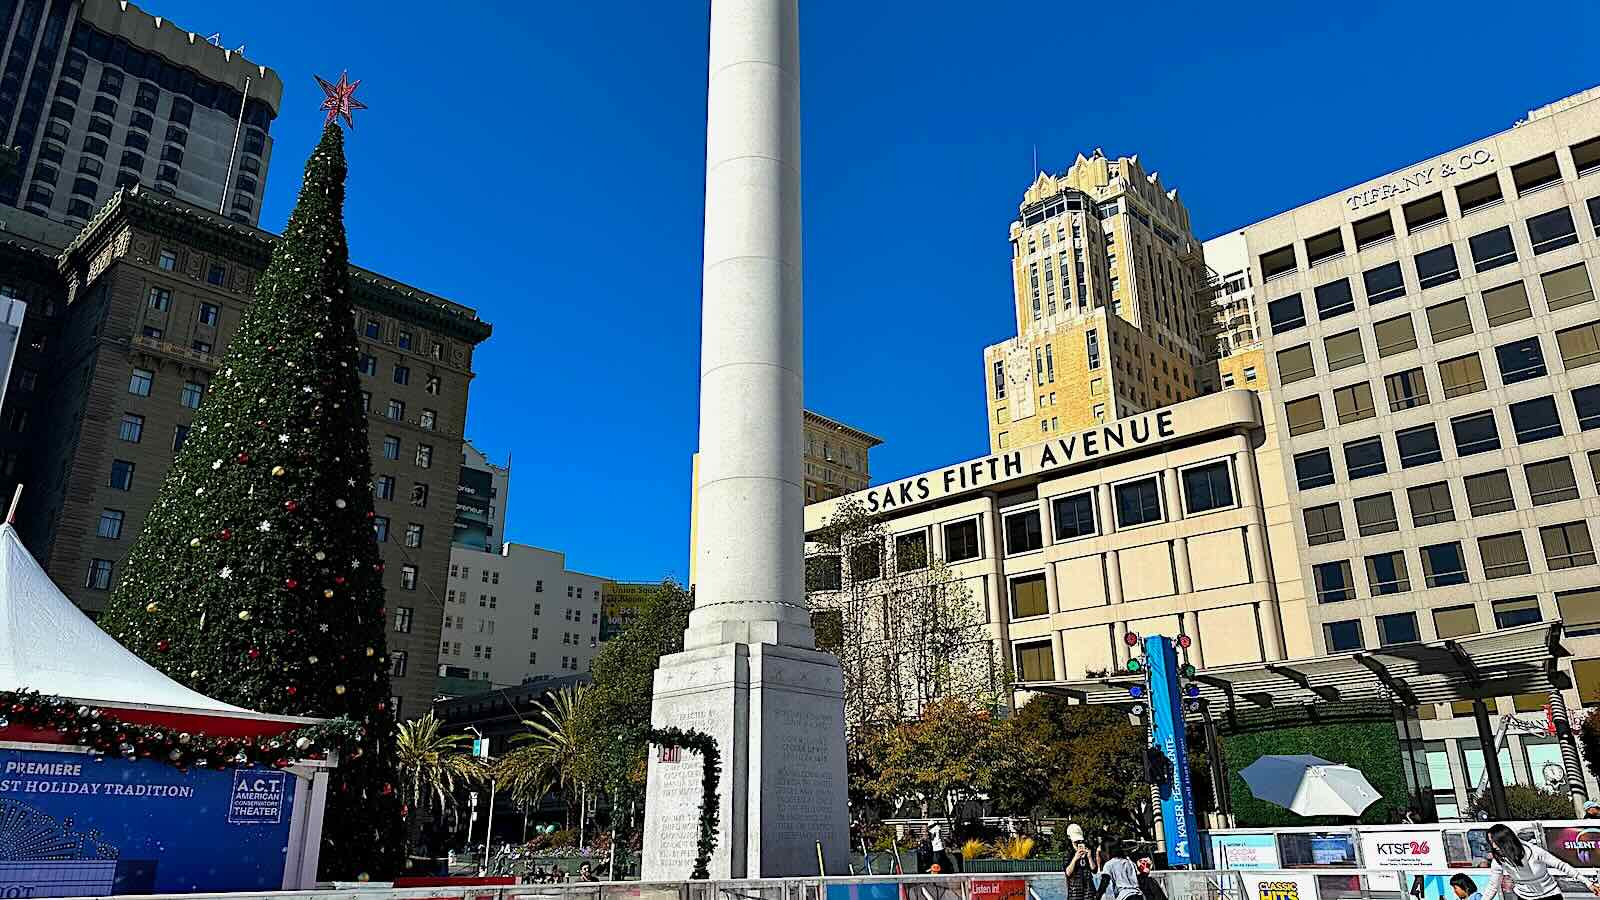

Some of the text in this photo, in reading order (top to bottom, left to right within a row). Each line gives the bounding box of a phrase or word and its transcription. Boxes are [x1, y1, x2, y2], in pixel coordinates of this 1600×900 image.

[1347, 149, 1495, 210] TIFFANY & CO.
[867, 410, 1175, 513] SAKS FIFTH AVENUE
[662, 745, 680, 760] EXIT
[5, 761, 82, 776] PREMIERE
[24, 781, 101, 795] HOLIDAY
[104, 783, 194, 798] TRADITION!
[237, 779, 280, 793] A.C.T.
[235, 792, 280, 801] AMERICAN
[234, 806, 278, 816] THEATER
[1174, 804, 1187, 838] KAISER
[1376, 841, 1430, 855] KTSF26
[1564, 841, 1596, 849] SILENT
[973, 882, 991, 894] Listen
[1258, 881, 1298, 891] CLASSIC
